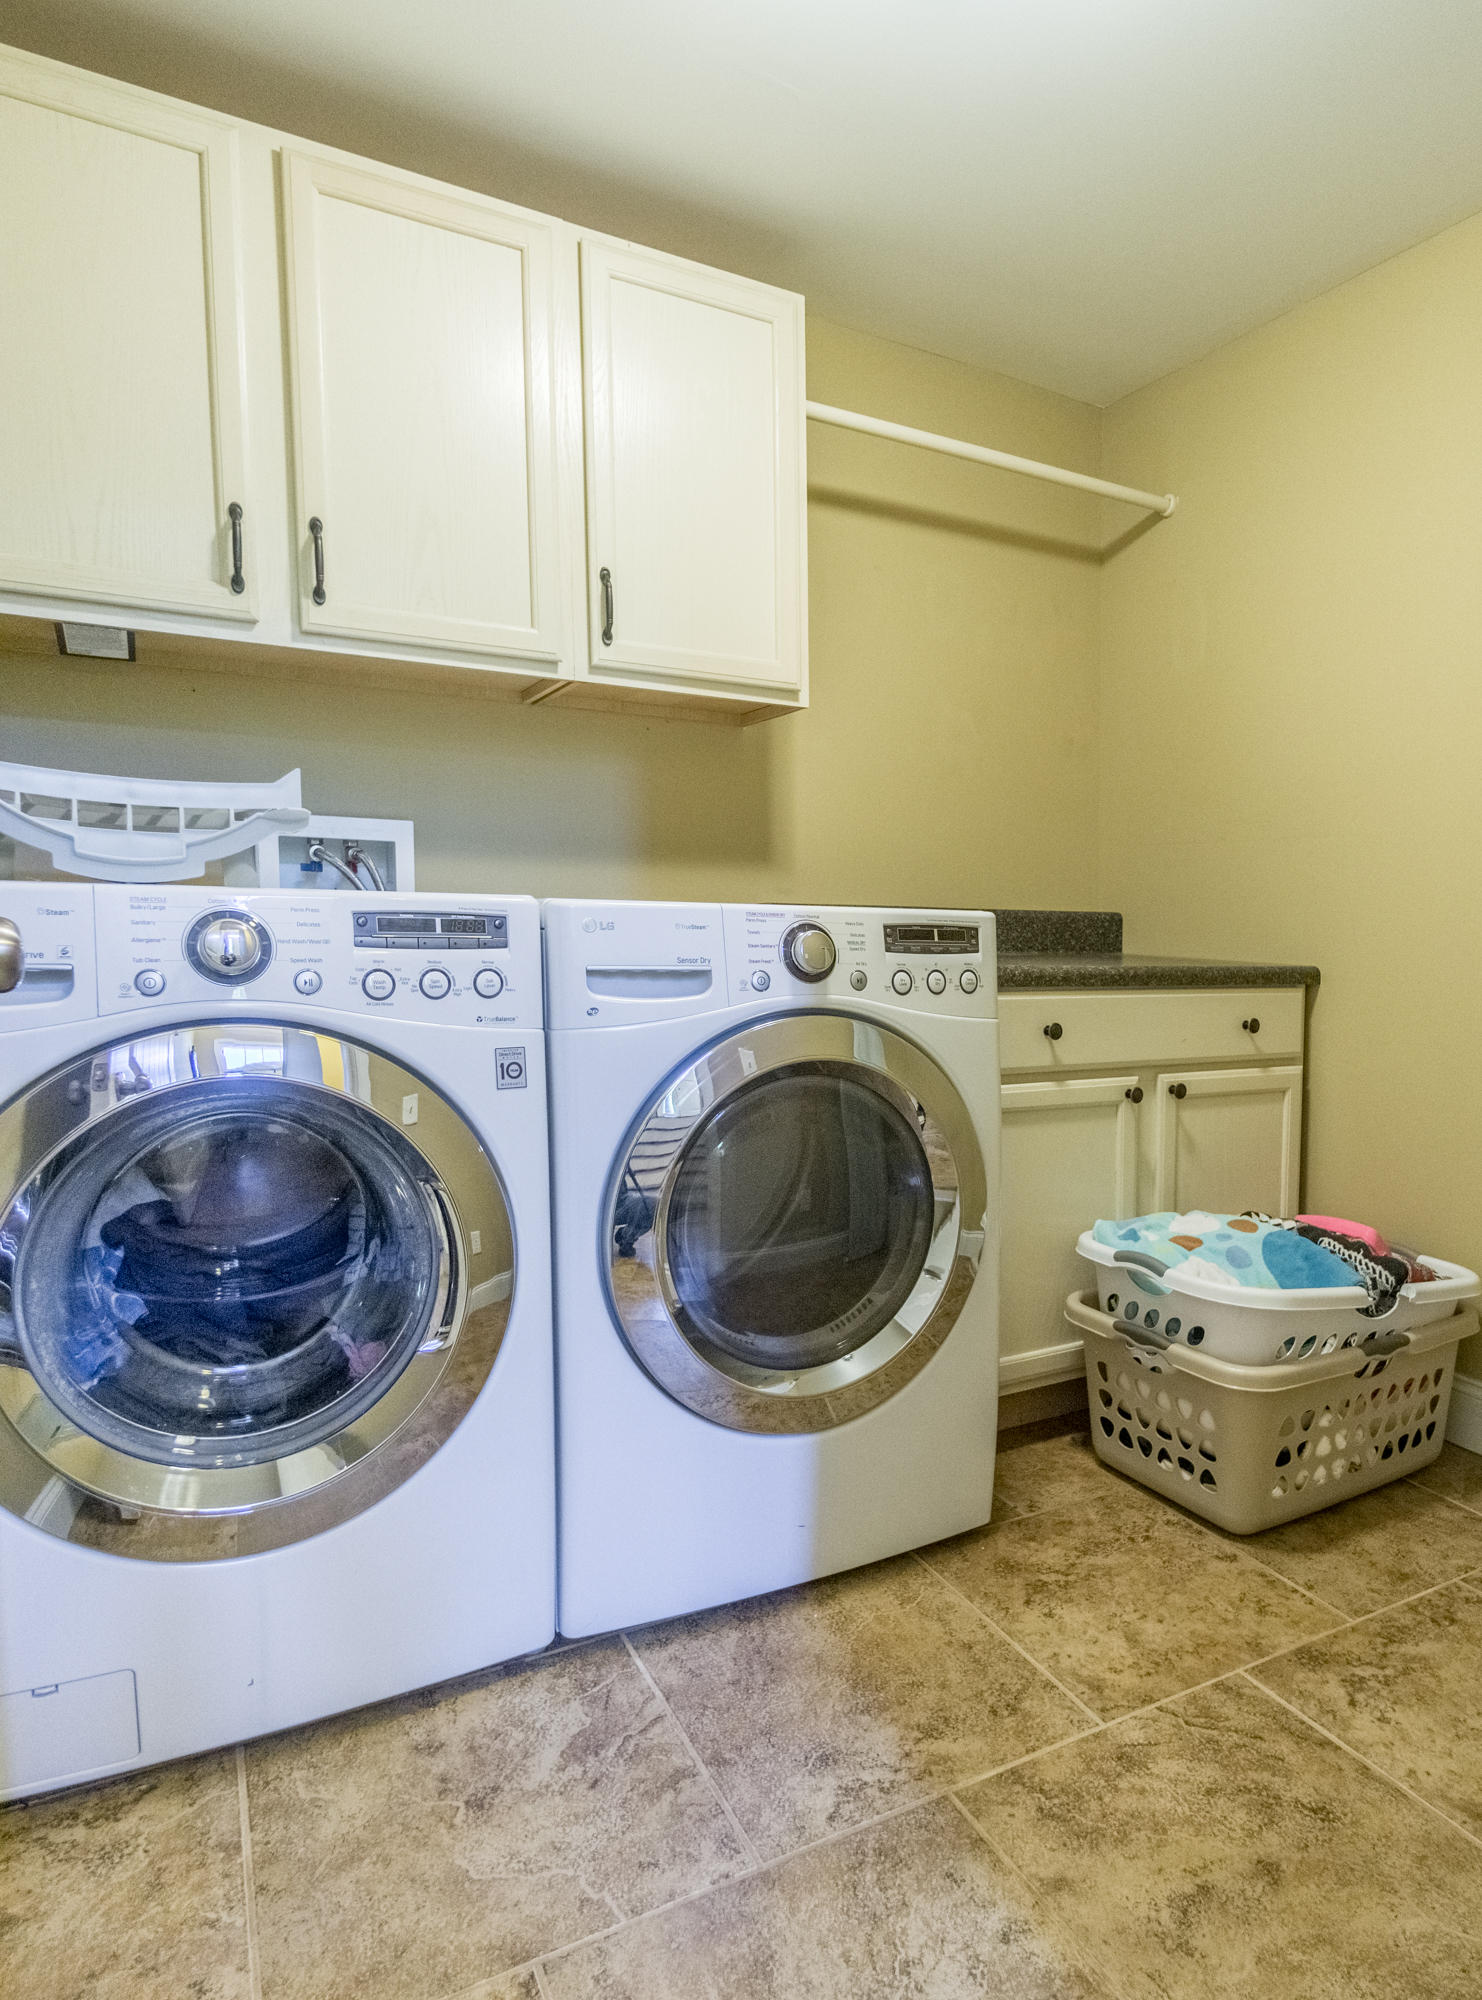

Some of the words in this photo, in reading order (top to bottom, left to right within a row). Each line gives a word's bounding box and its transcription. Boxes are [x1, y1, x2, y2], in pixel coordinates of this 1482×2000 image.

[599, 920, 616, 931] LG
[676, 956, 699, 965] Sensor
[700, 956, 712, 966] Dry
[500, 1061, 523, 1080] 10
